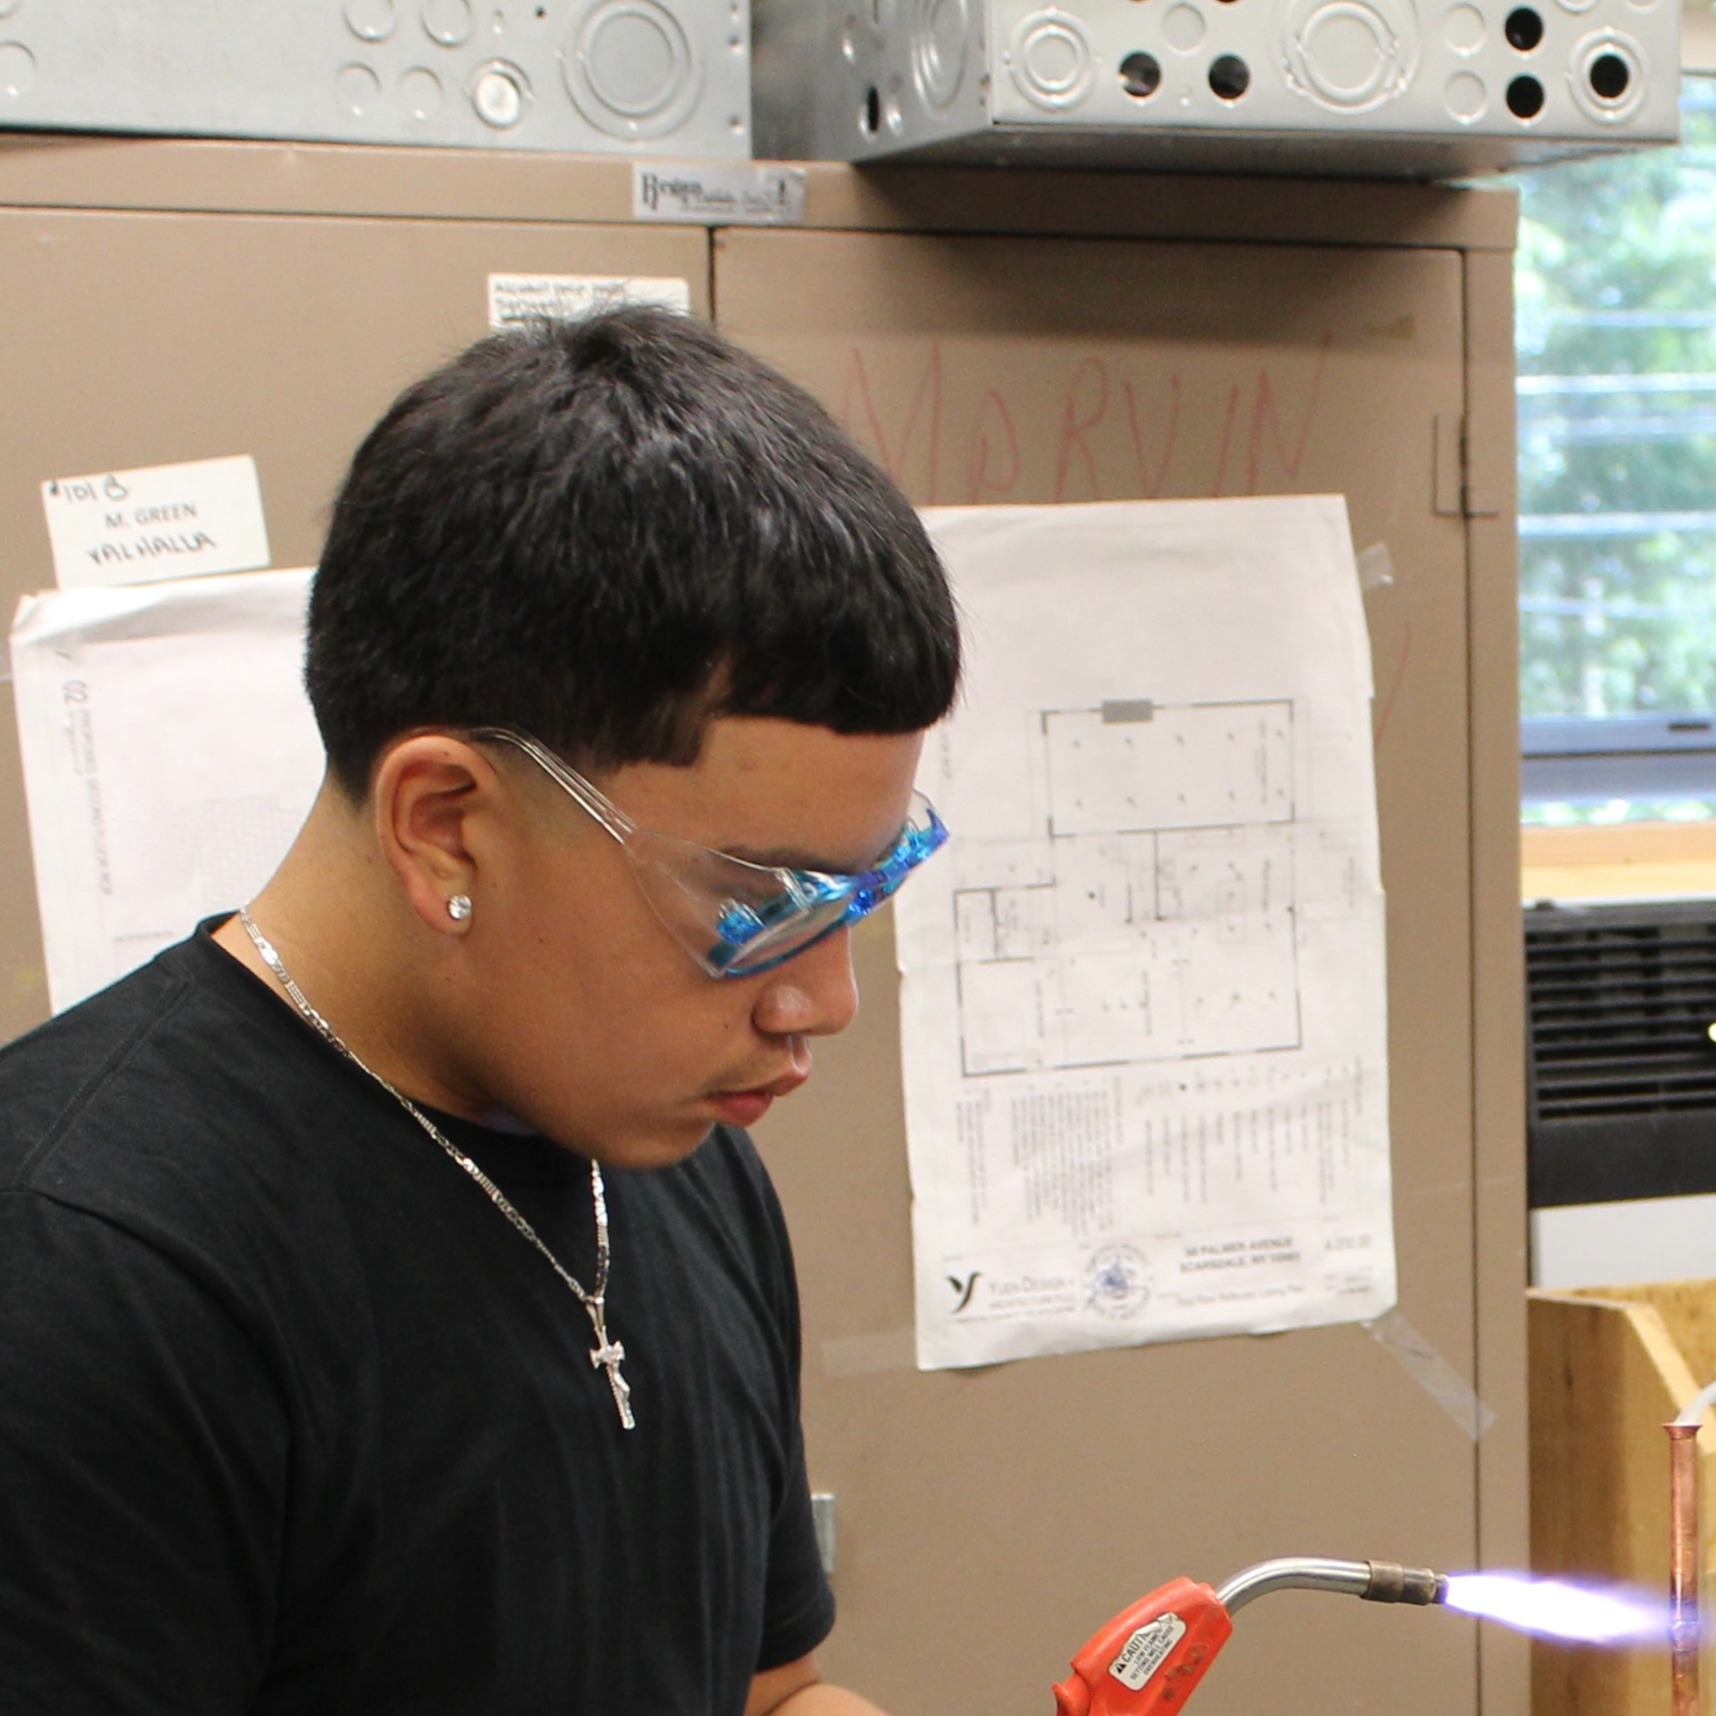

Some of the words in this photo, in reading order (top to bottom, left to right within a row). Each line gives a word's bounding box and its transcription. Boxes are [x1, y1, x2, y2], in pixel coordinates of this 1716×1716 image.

[135, 503, 198, 526] GREEN
[86, 531, 217, 566] VALHALLA
[1200, 1240, 1246, 1255] PALMER
[1249, 1236, 1293, 1250] AVENUE
[1120, 1626, 1152, 1664] CAUTI
[1129, 1656, 1151, 1680] SETTING
[1157, 1624, 1174, 1645] CAUSE
[1142, 1638, 1174, 1677] OVERHEATING
